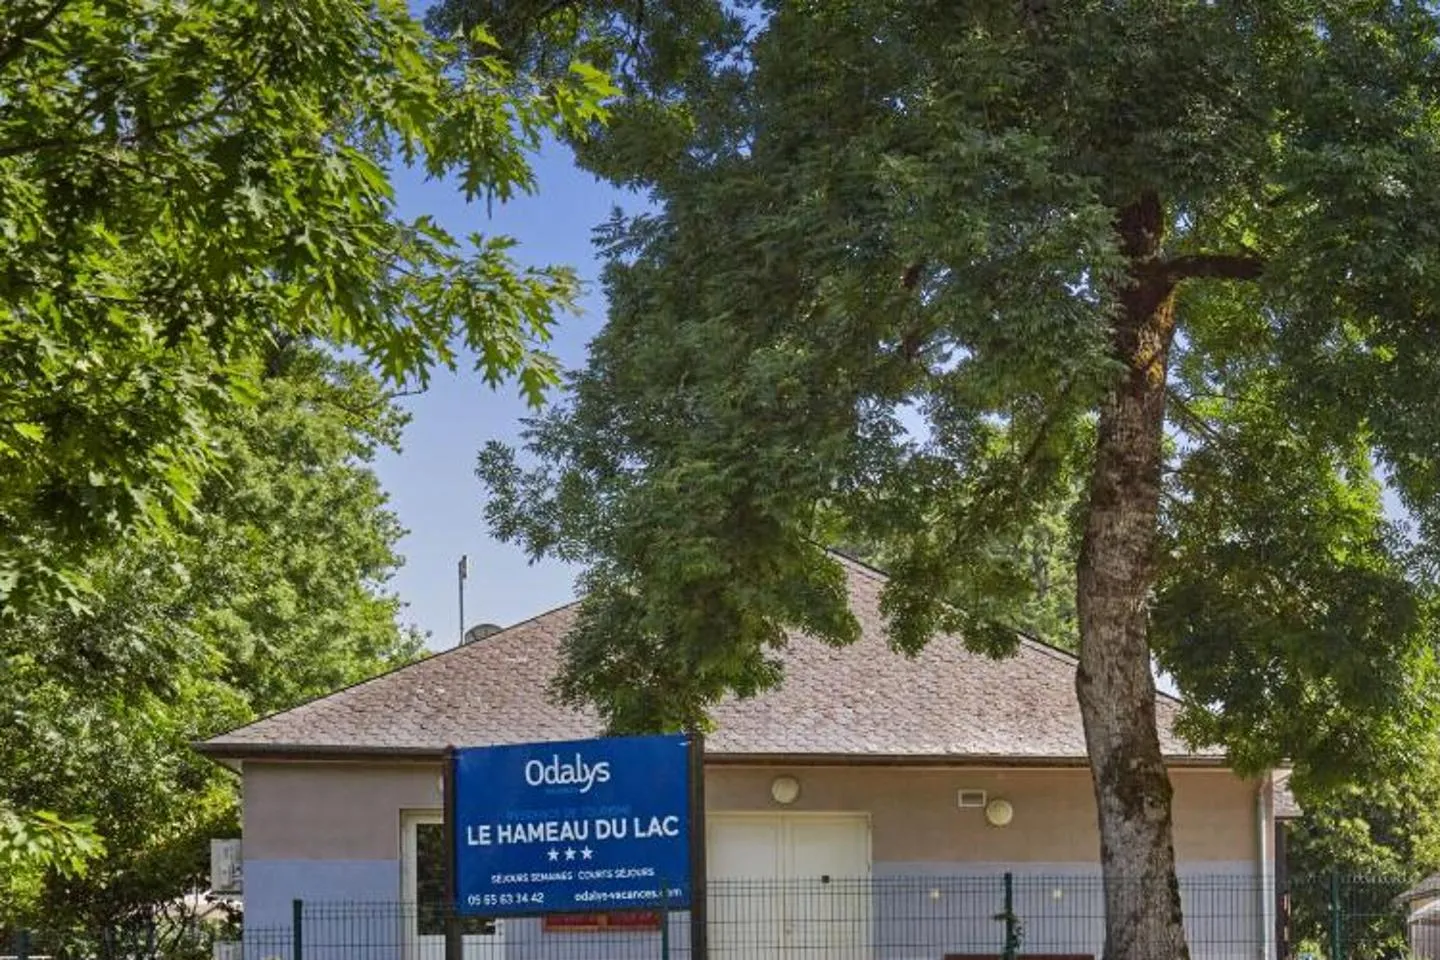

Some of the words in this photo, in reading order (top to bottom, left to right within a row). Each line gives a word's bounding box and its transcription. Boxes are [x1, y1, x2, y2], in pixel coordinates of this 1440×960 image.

[525, 752, 611, 793] Odalys
[467, 825, 491, 845] LE
[498, 819, 589, 844] HAMEAU
[595, 818, 627, 839] DU
[634, 816, 680, 837] LAC
[578, 868, 613, 880] COURTS
[574, 887, 683, 902] odalys-vacances.cm
